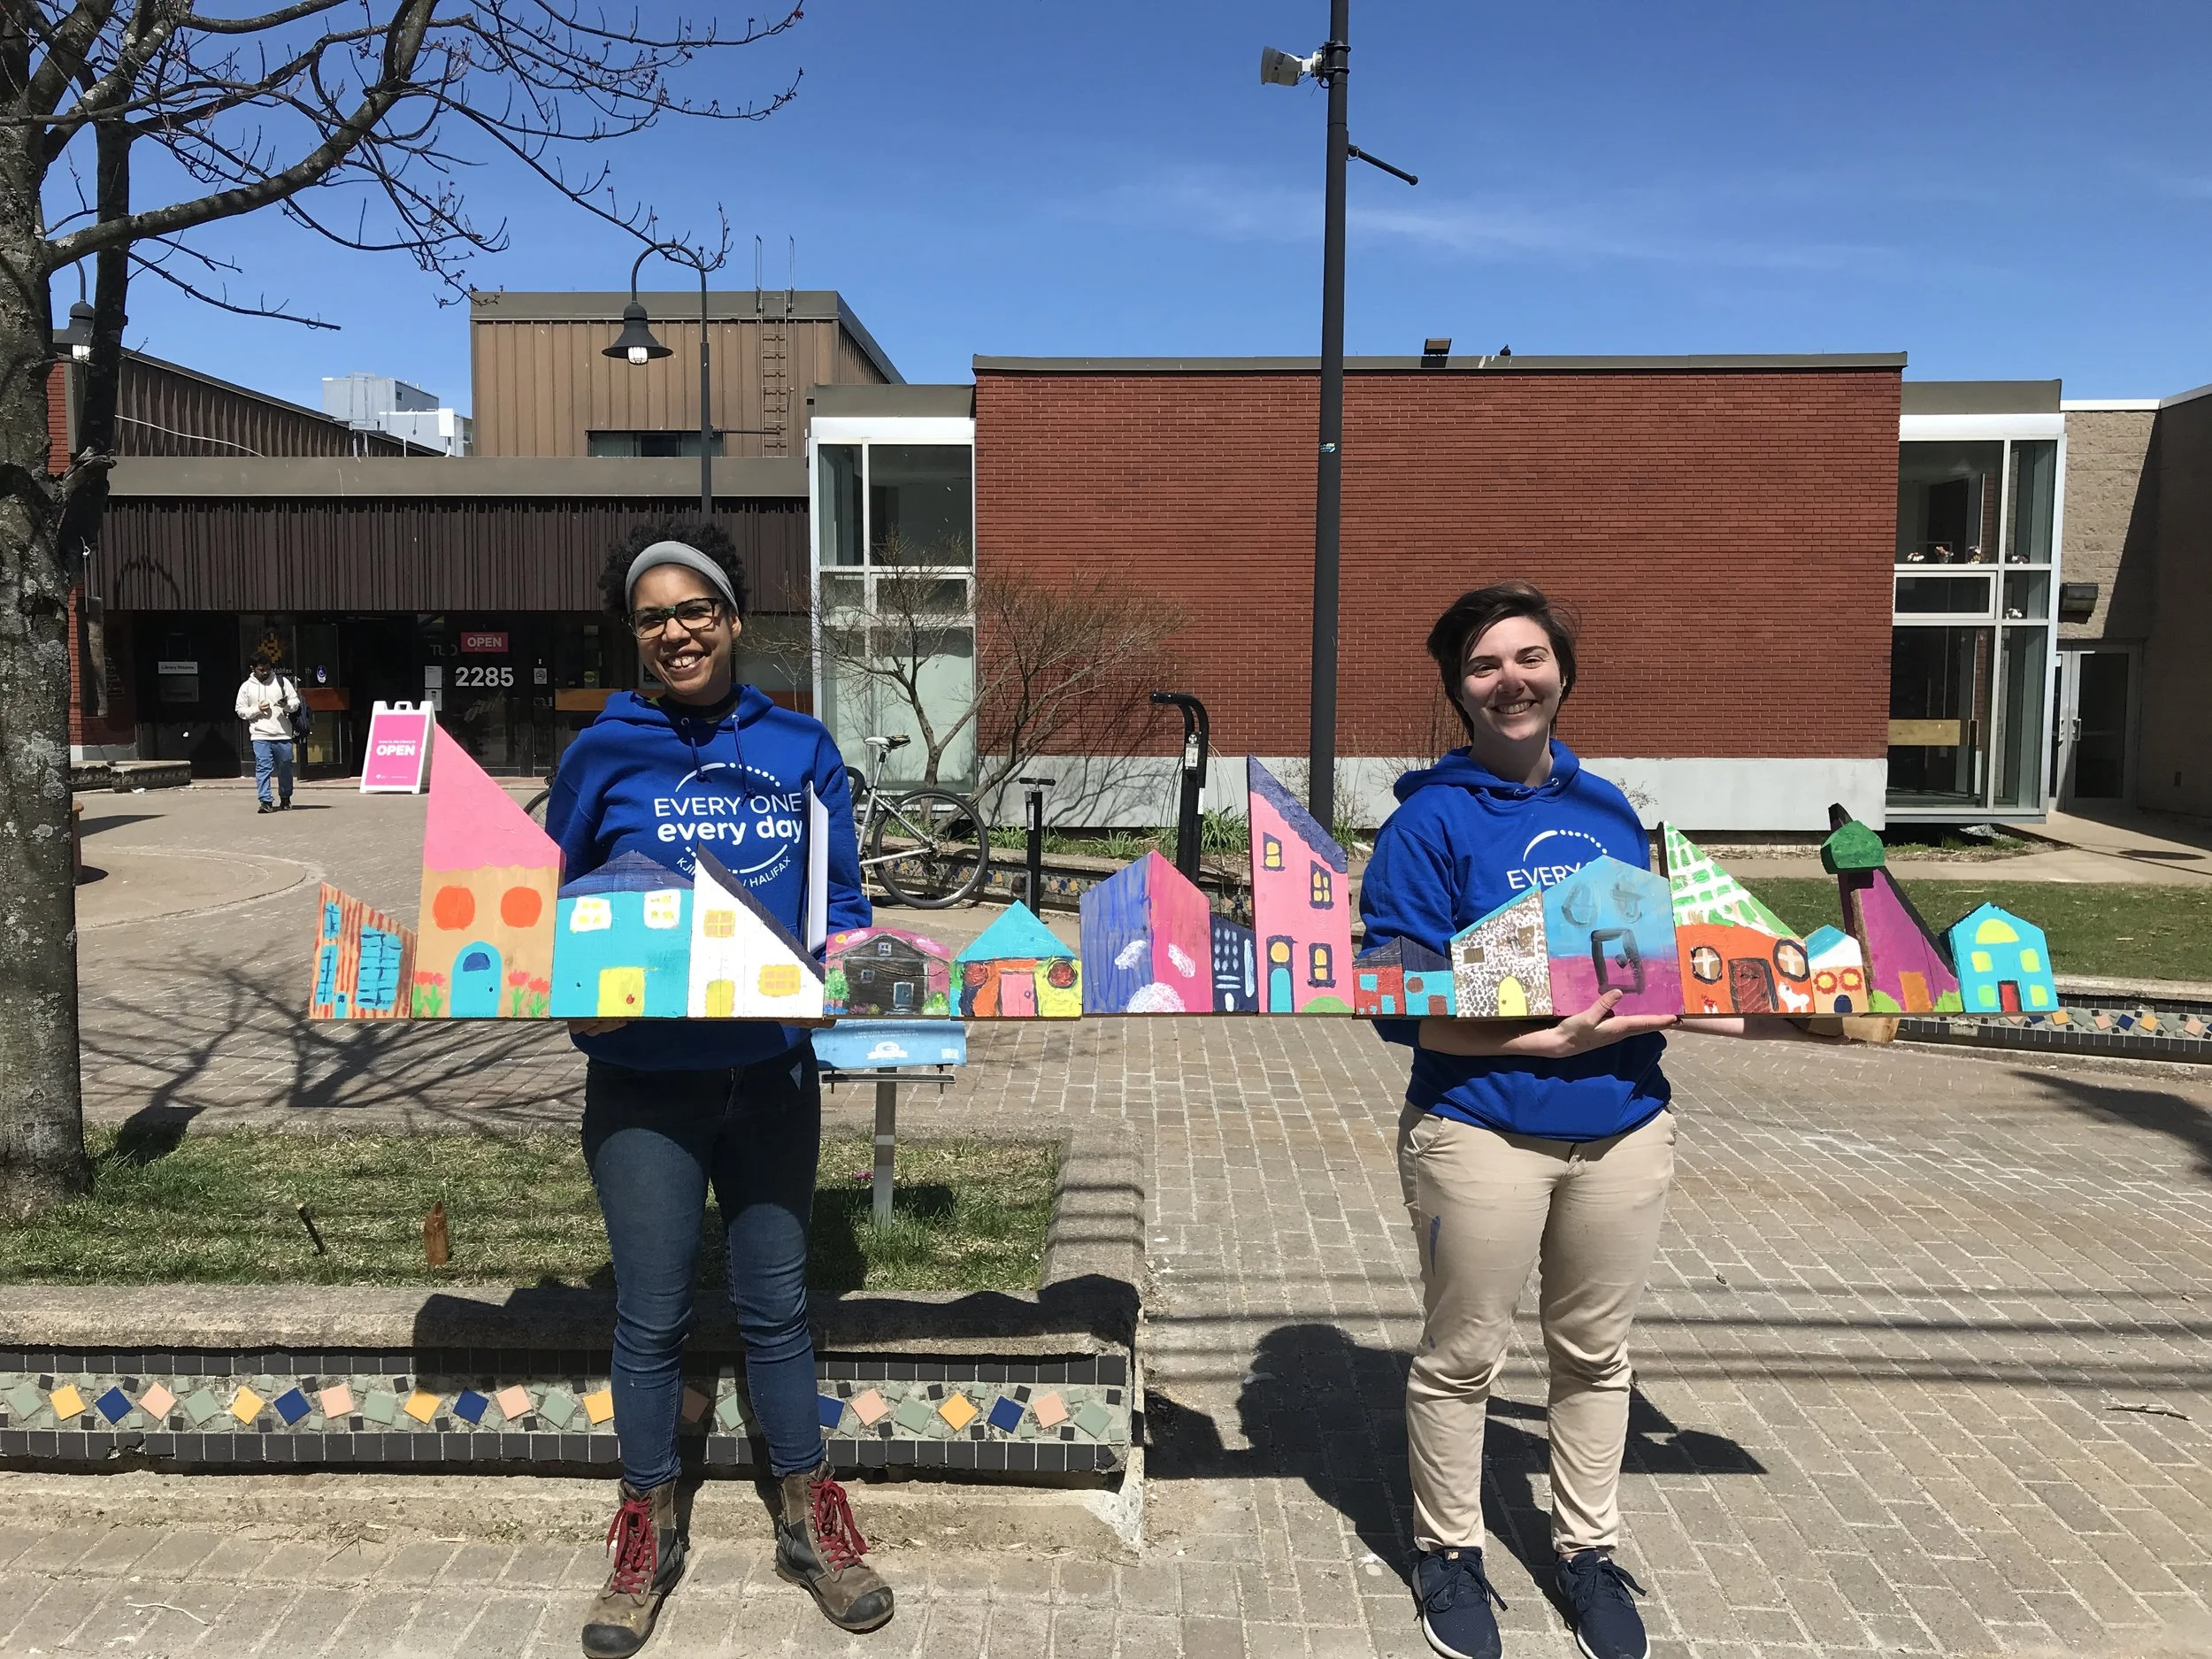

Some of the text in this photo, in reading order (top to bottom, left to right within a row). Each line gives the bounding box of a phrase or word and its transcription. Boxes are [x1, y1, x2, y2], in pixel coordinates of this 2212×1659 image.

[467, 637, 503, 648] OPEN
[455, 666, 514, 687] 2285
[376, 744, 415, 756] OPEN
[654, 793, 803, 818] EVERY ONE
[657, 815, 803, 846] every day
[749, 856, 791, 887] HALIFAX
[1507, 862, 1580, 889] EVERY
